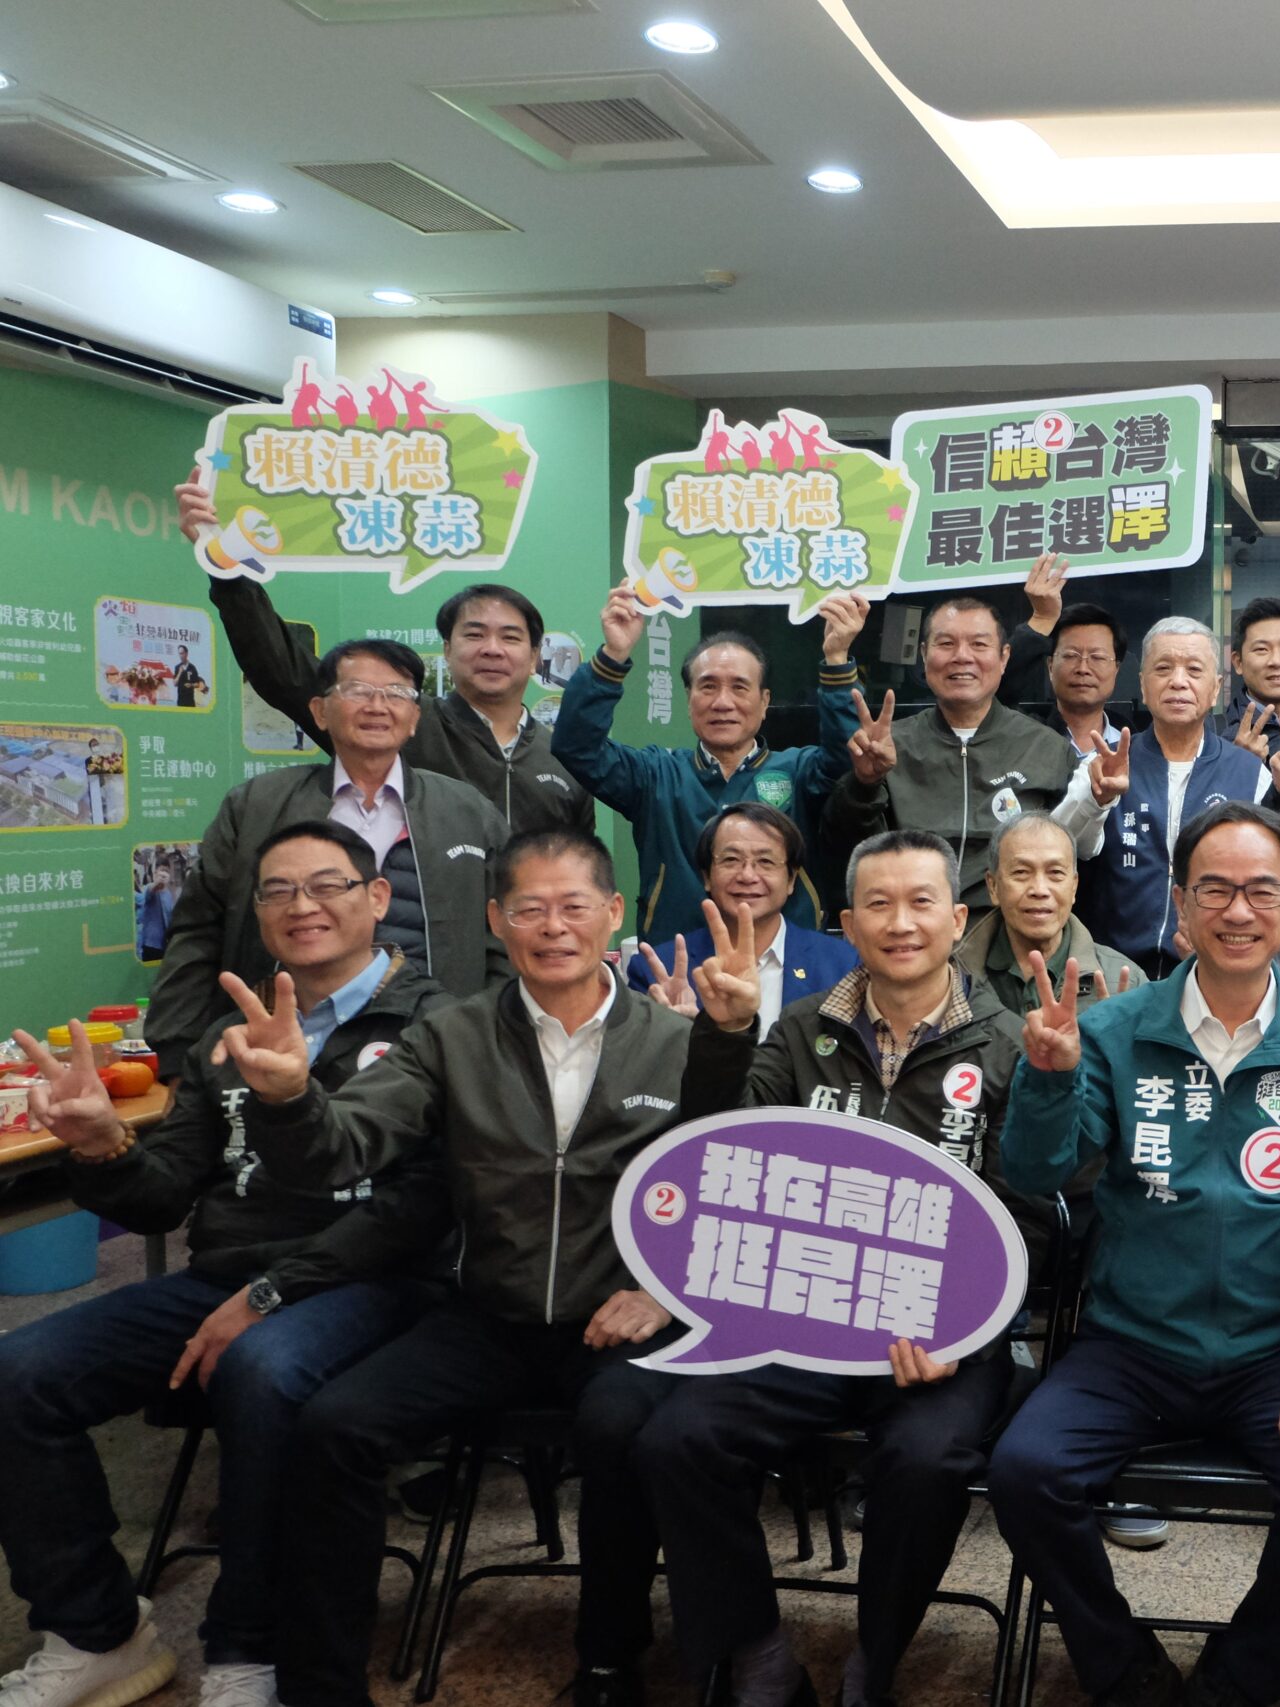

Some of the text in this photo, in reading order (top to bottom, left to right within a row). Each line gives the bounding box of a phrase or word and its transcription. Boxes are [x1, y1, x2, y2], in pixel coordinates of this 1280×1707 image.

[929, 413, 1172, 494] 信賴台灣
[1043, 417, 1065, 447] 2
[250, 433, 447, 491] 賴清德
[342, 499, 482, 551] 凍蒜
[669, 474, 839, 530] 賴清德
[926, 482, 1170, 567] 最佳選澤
[747, 534, 868, 583] 凍蒜
[139, 735, 166, 755] 爭取
[139, 759, 217, 778] 三民運動中心
[0, 869, 84, 895] 換自來水管
[622, 1094, 677, 1112] TEAM TAIWAN
[952, 1071, 978, 1103] 2
[1184, 1060, 1213, 1123] 立委
[1131, 1075, 1178, 1204] 李昆澤
[653, 1187, 675, 1219] 2
[699, 1141, 953, 1250] 我在高雄
[684, 1213, 944, 1340] 挺昆澤
